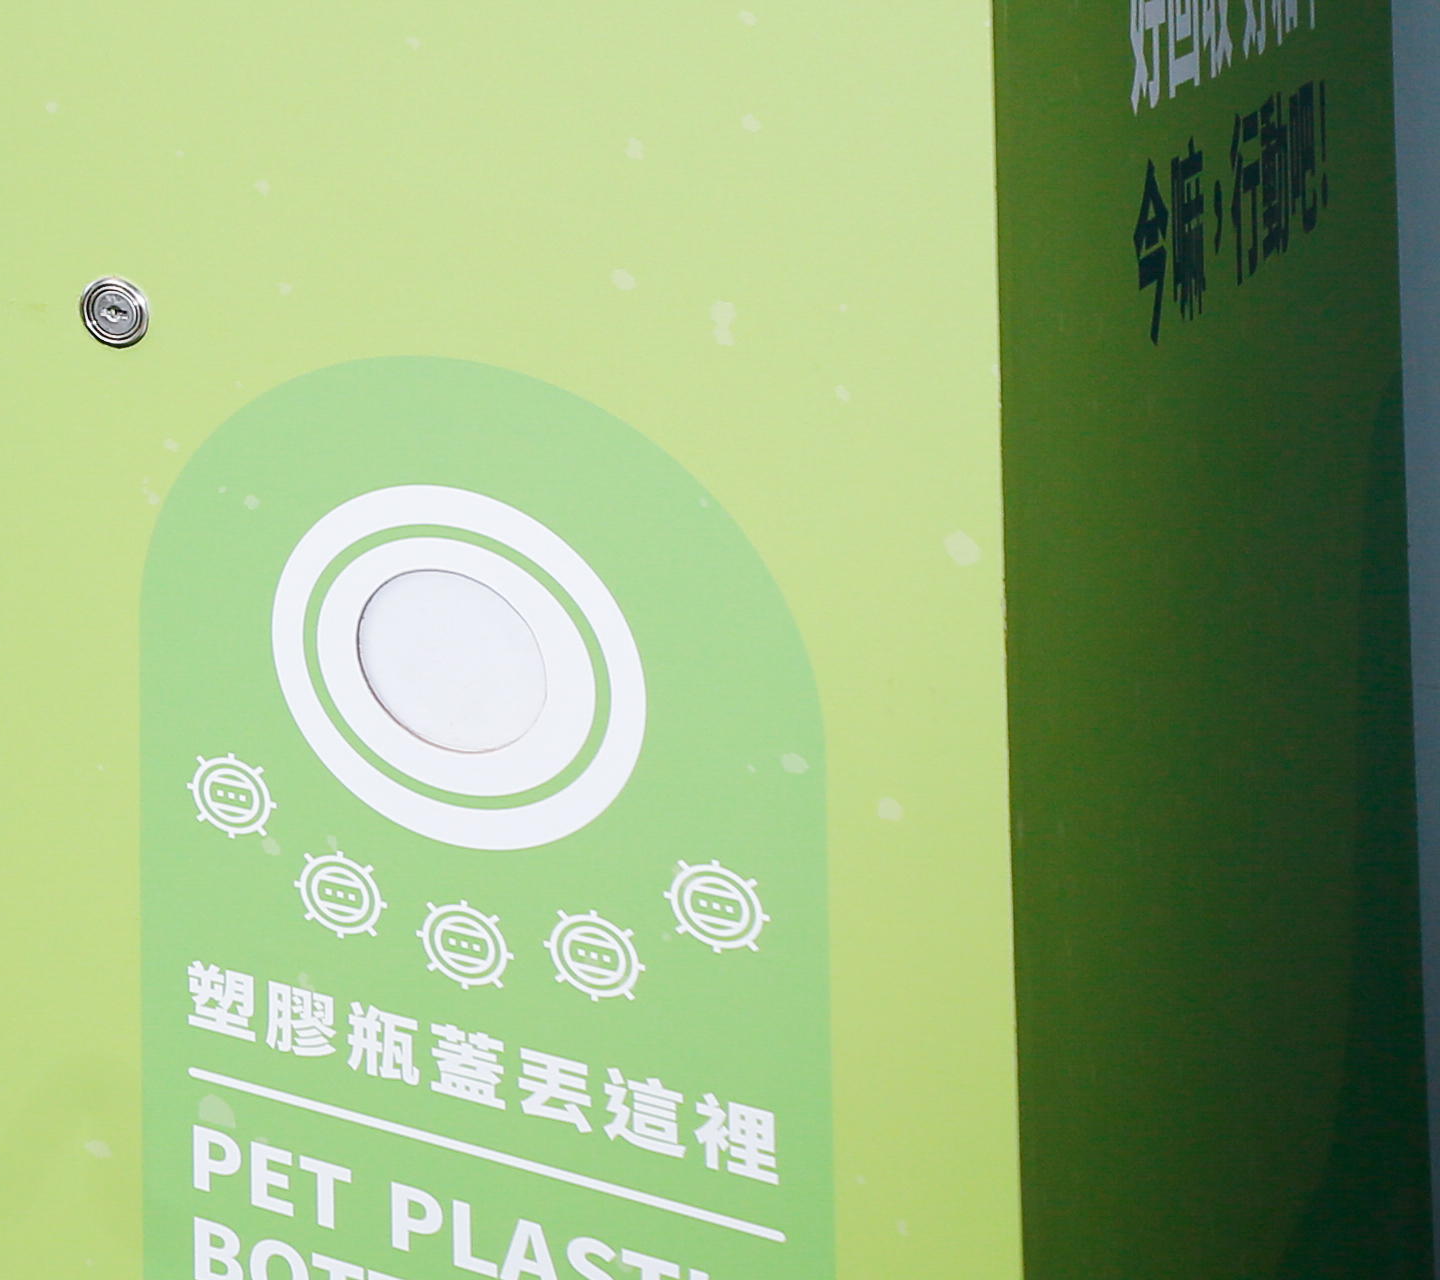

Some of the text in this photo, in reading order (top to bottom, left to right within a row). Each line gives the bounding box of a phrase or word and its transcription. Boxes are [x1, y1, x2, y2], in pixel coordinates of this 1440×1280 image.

[186, 959, 781, 1187] 塑膠瓶蓋丟這裡
[191, 1123, 353, 1230] PET
